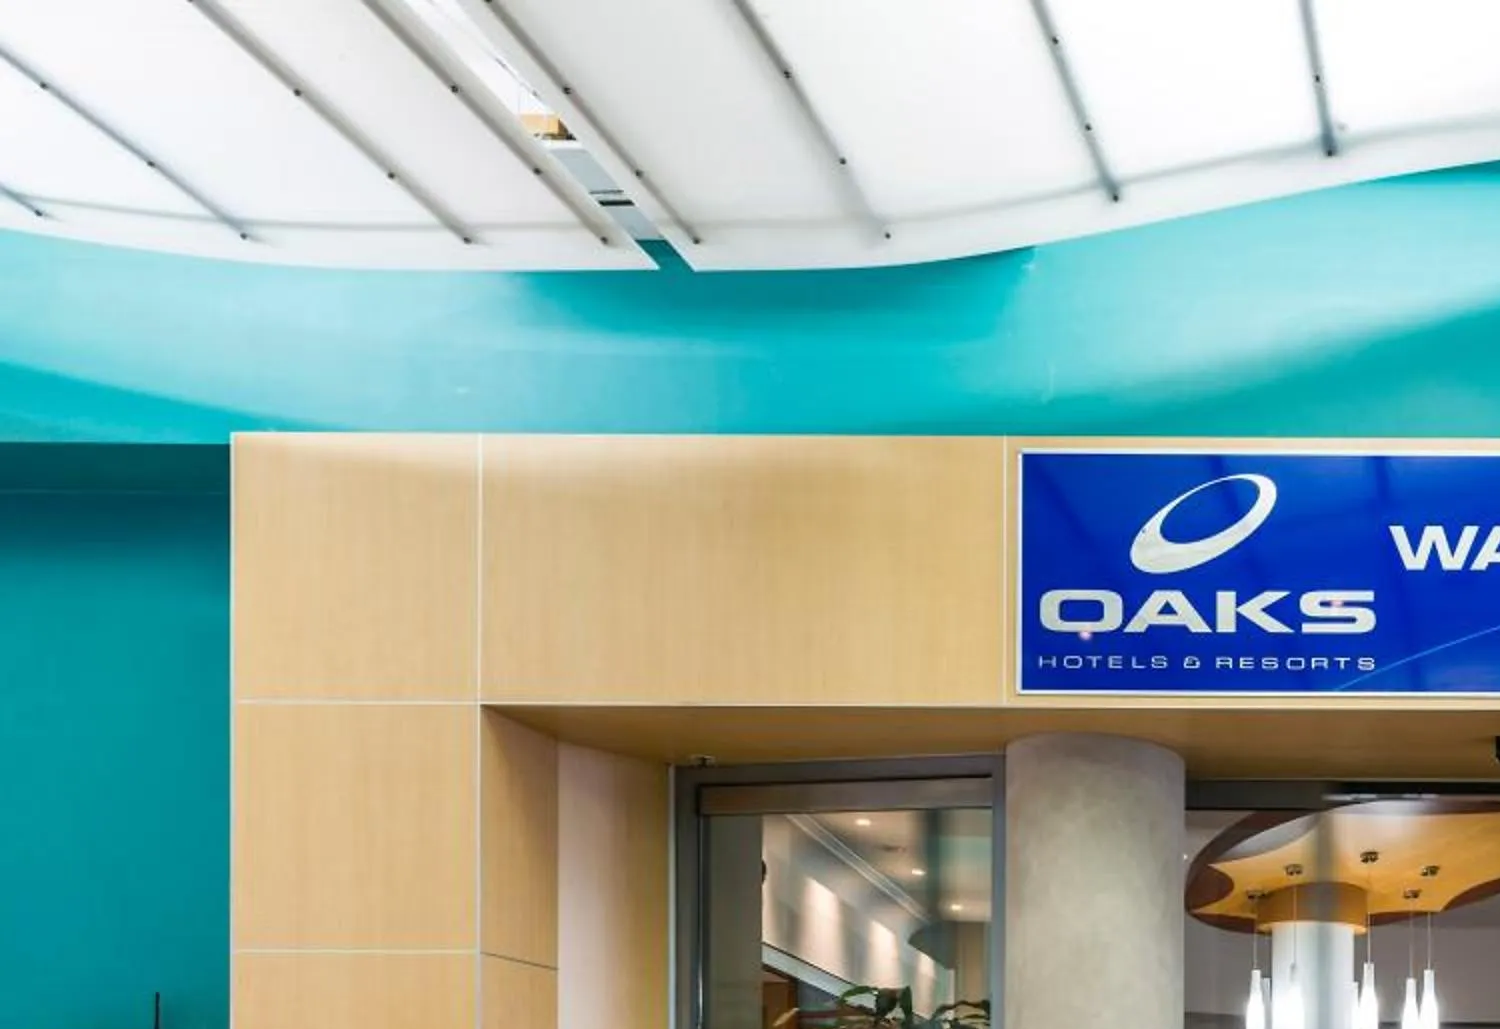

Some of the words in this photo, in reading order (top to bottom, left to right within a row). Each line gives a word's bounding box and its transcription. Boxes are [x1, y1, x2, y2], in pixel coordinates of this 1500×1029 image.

[1039, 589, 1377, 634] OAKS
[1038, 655, 1169, 670] HOTELS
[1183, 656, 1201, 670] &
[1215, 657, 1376, 671] RESORTS
